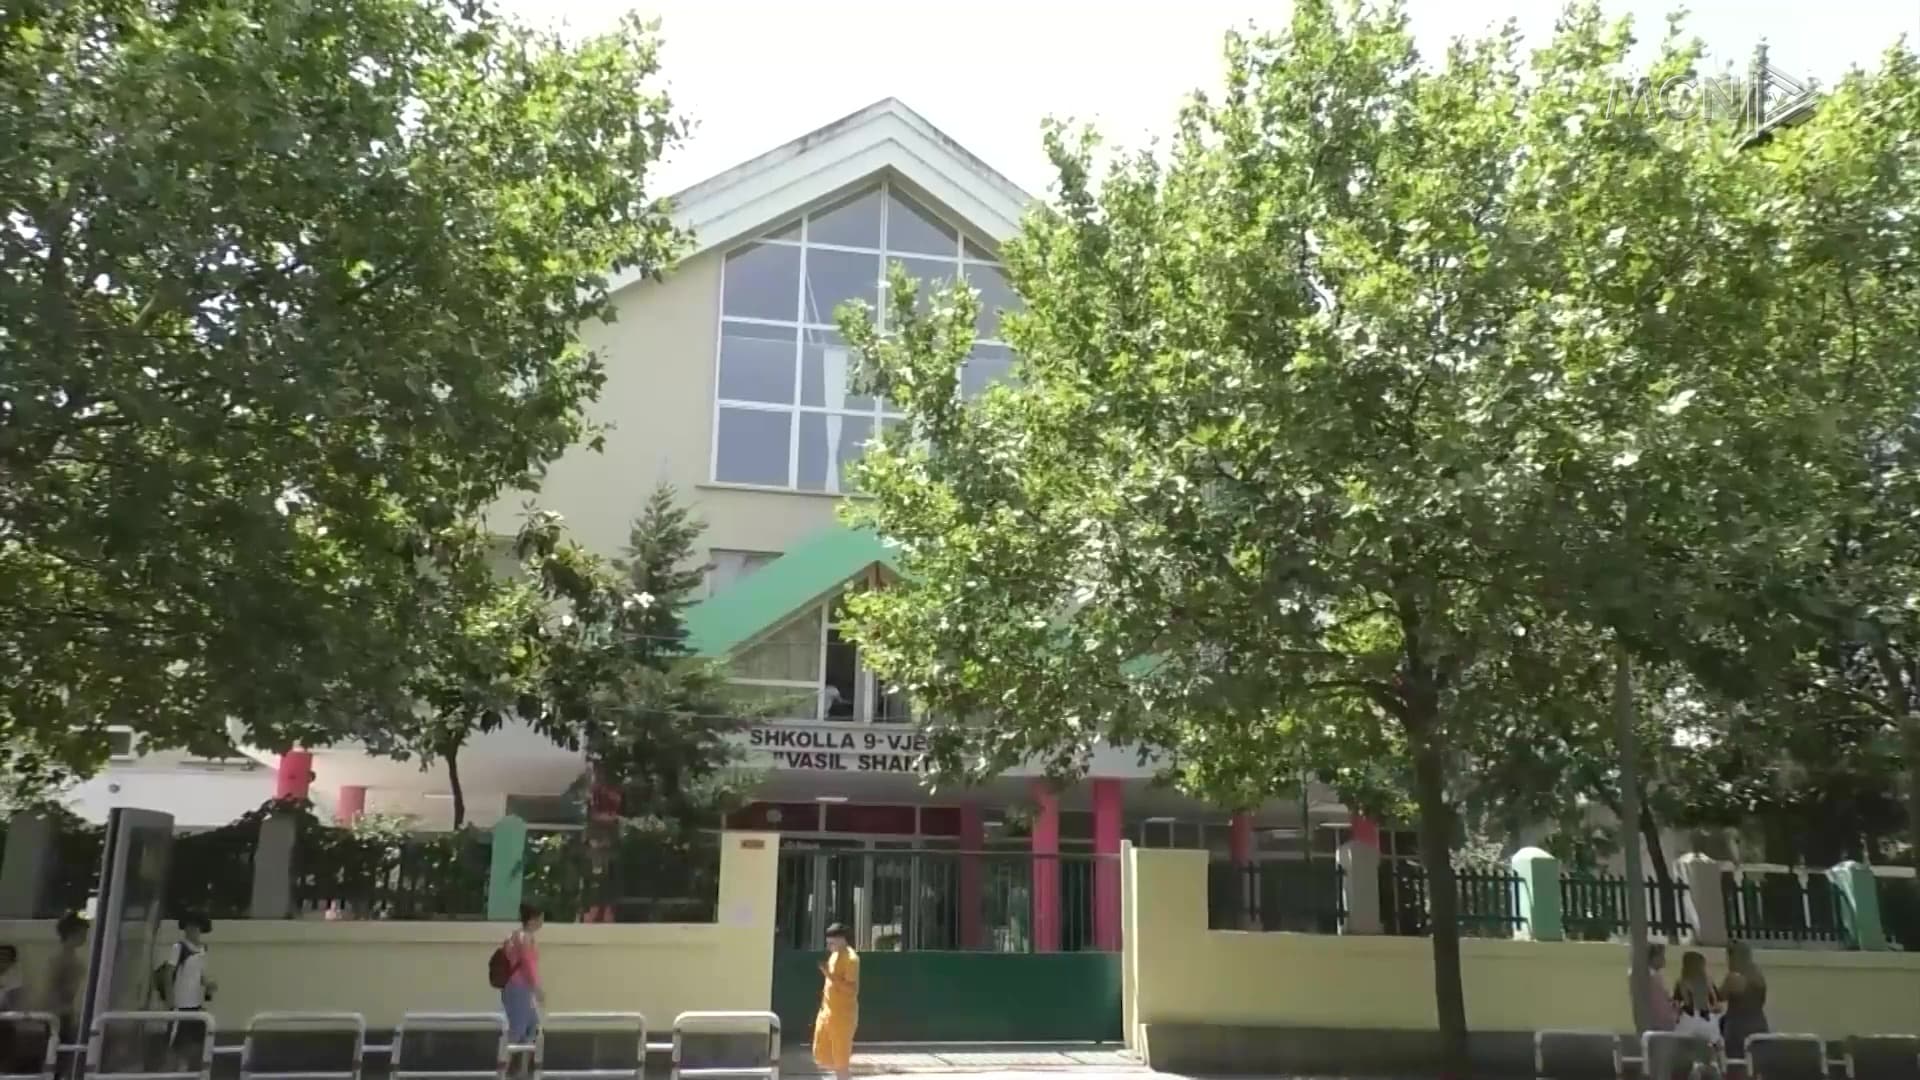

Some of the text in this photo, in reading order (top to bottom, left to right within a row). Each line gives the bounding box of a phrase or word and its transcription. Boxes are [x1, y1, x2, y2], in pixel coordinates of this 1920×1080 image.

[751, 729, 928, 751] SHKOLLA 9-VJE
[773, 751, 932, 773] "VASIL SHANT
